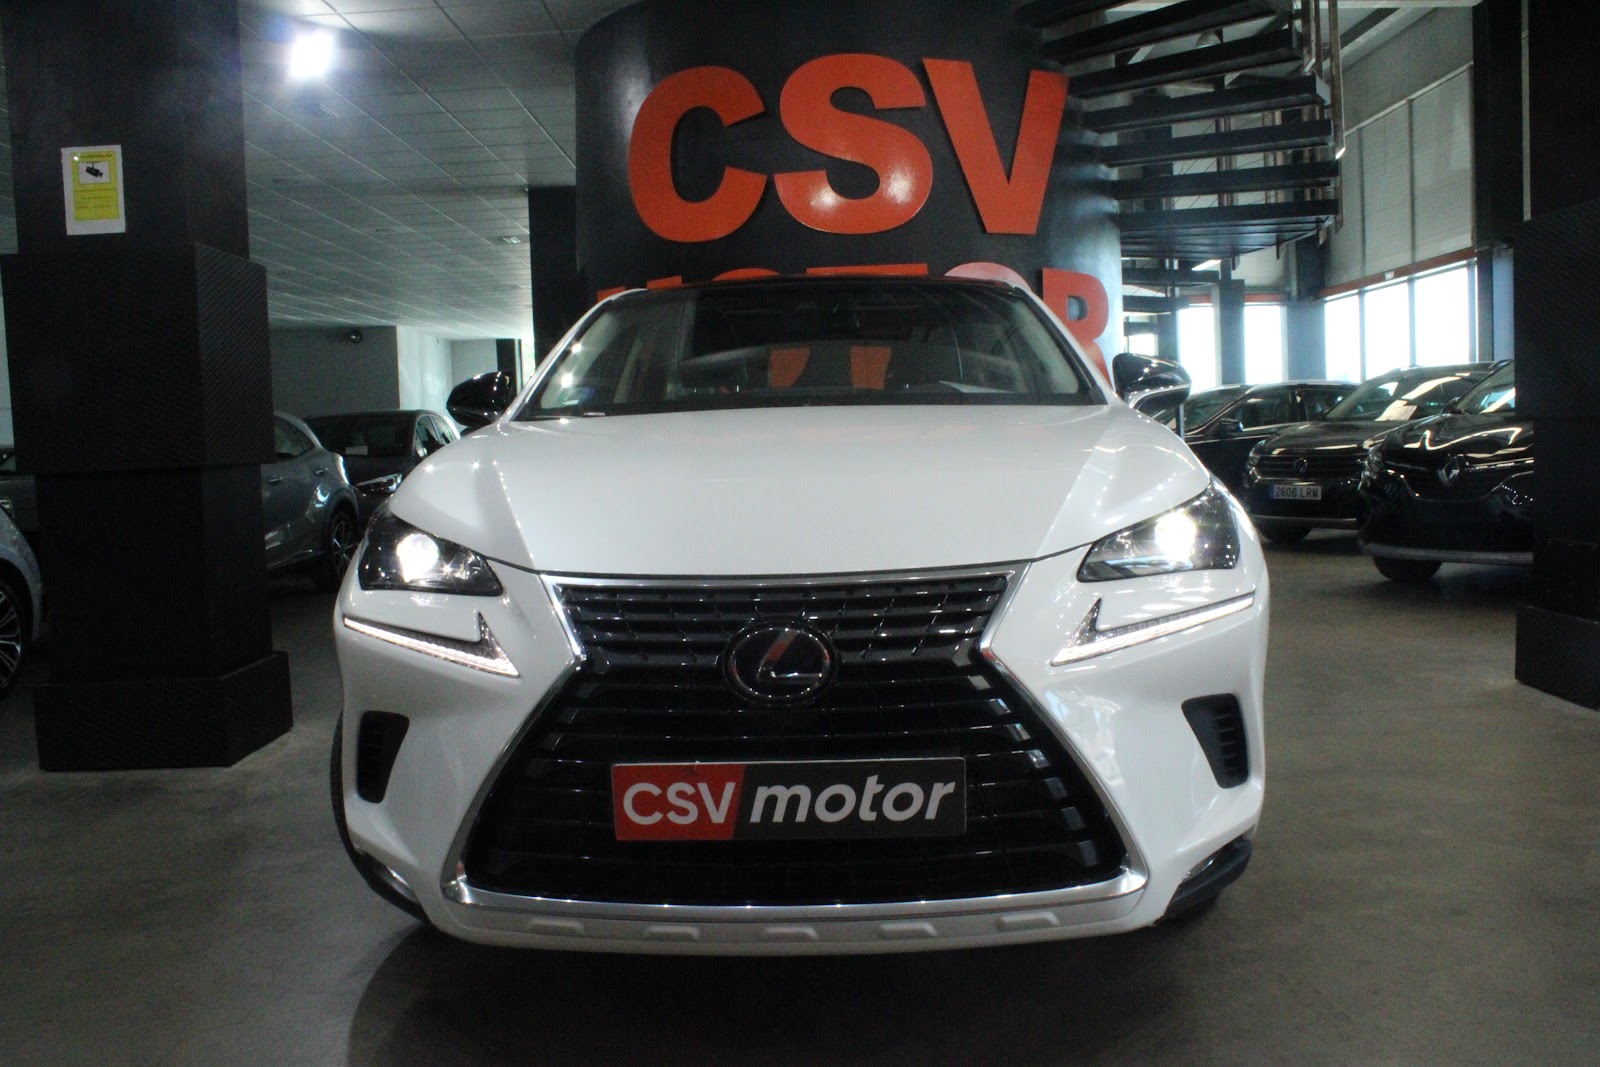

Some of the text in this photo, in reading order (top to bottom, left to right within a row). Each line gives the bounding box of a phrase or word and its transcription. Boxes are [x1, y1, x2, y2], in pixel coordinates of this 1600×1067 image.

[628, 53, 1068, 242] CSV
[622, 774, 955, 825] CSV motor
